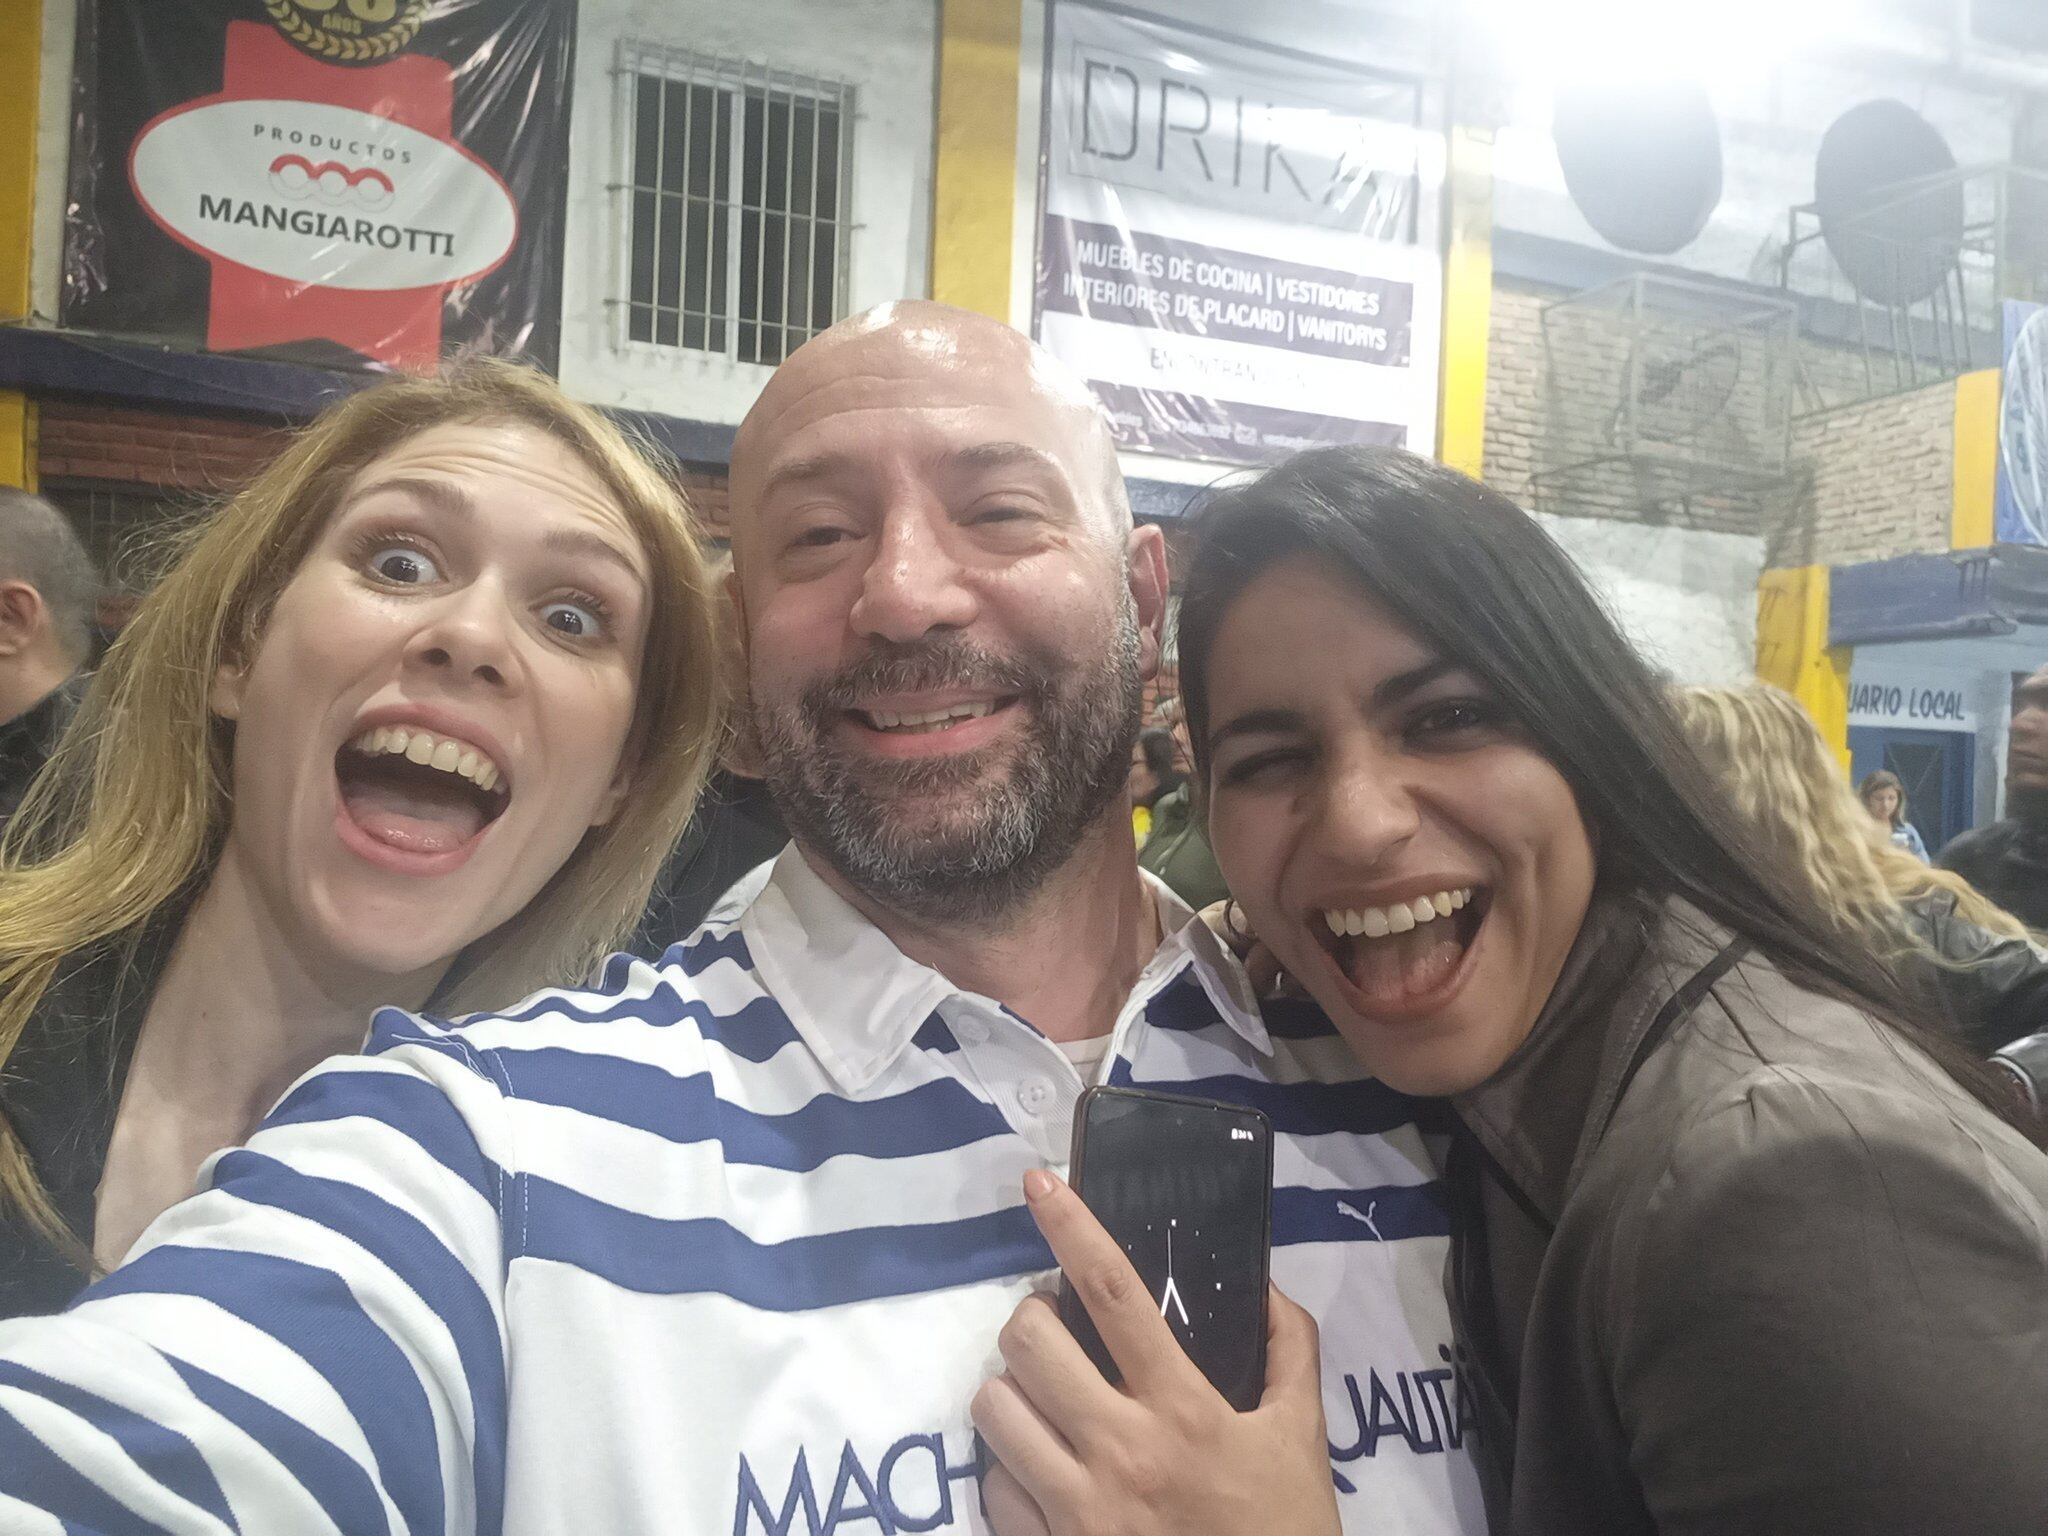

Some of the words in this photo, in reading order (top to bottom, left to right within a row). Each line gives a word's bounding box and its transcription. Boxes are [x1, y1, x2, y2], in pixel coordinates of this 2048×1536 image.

[253, 123, 413, 165] PRODUCTOS
[199, 194, 455, 258] MANGIAROTTI
[1077, 239, 1164, 277] MUEBLES
[1169, 257, 1193, 283] DE
[1196, 262, 1263, 296] COCINA
[1276, 276, 1380, 316] VESTIDORES
[1063, 273, 1171, 316] INTERIORES
[1174, 293, 1199, 320] DE
[1203, 299, 1285, 333] PLACARD
[1298, 314, 1388, 351] VANITORYS
[1908, 686, 1965, 721] LOCAL
